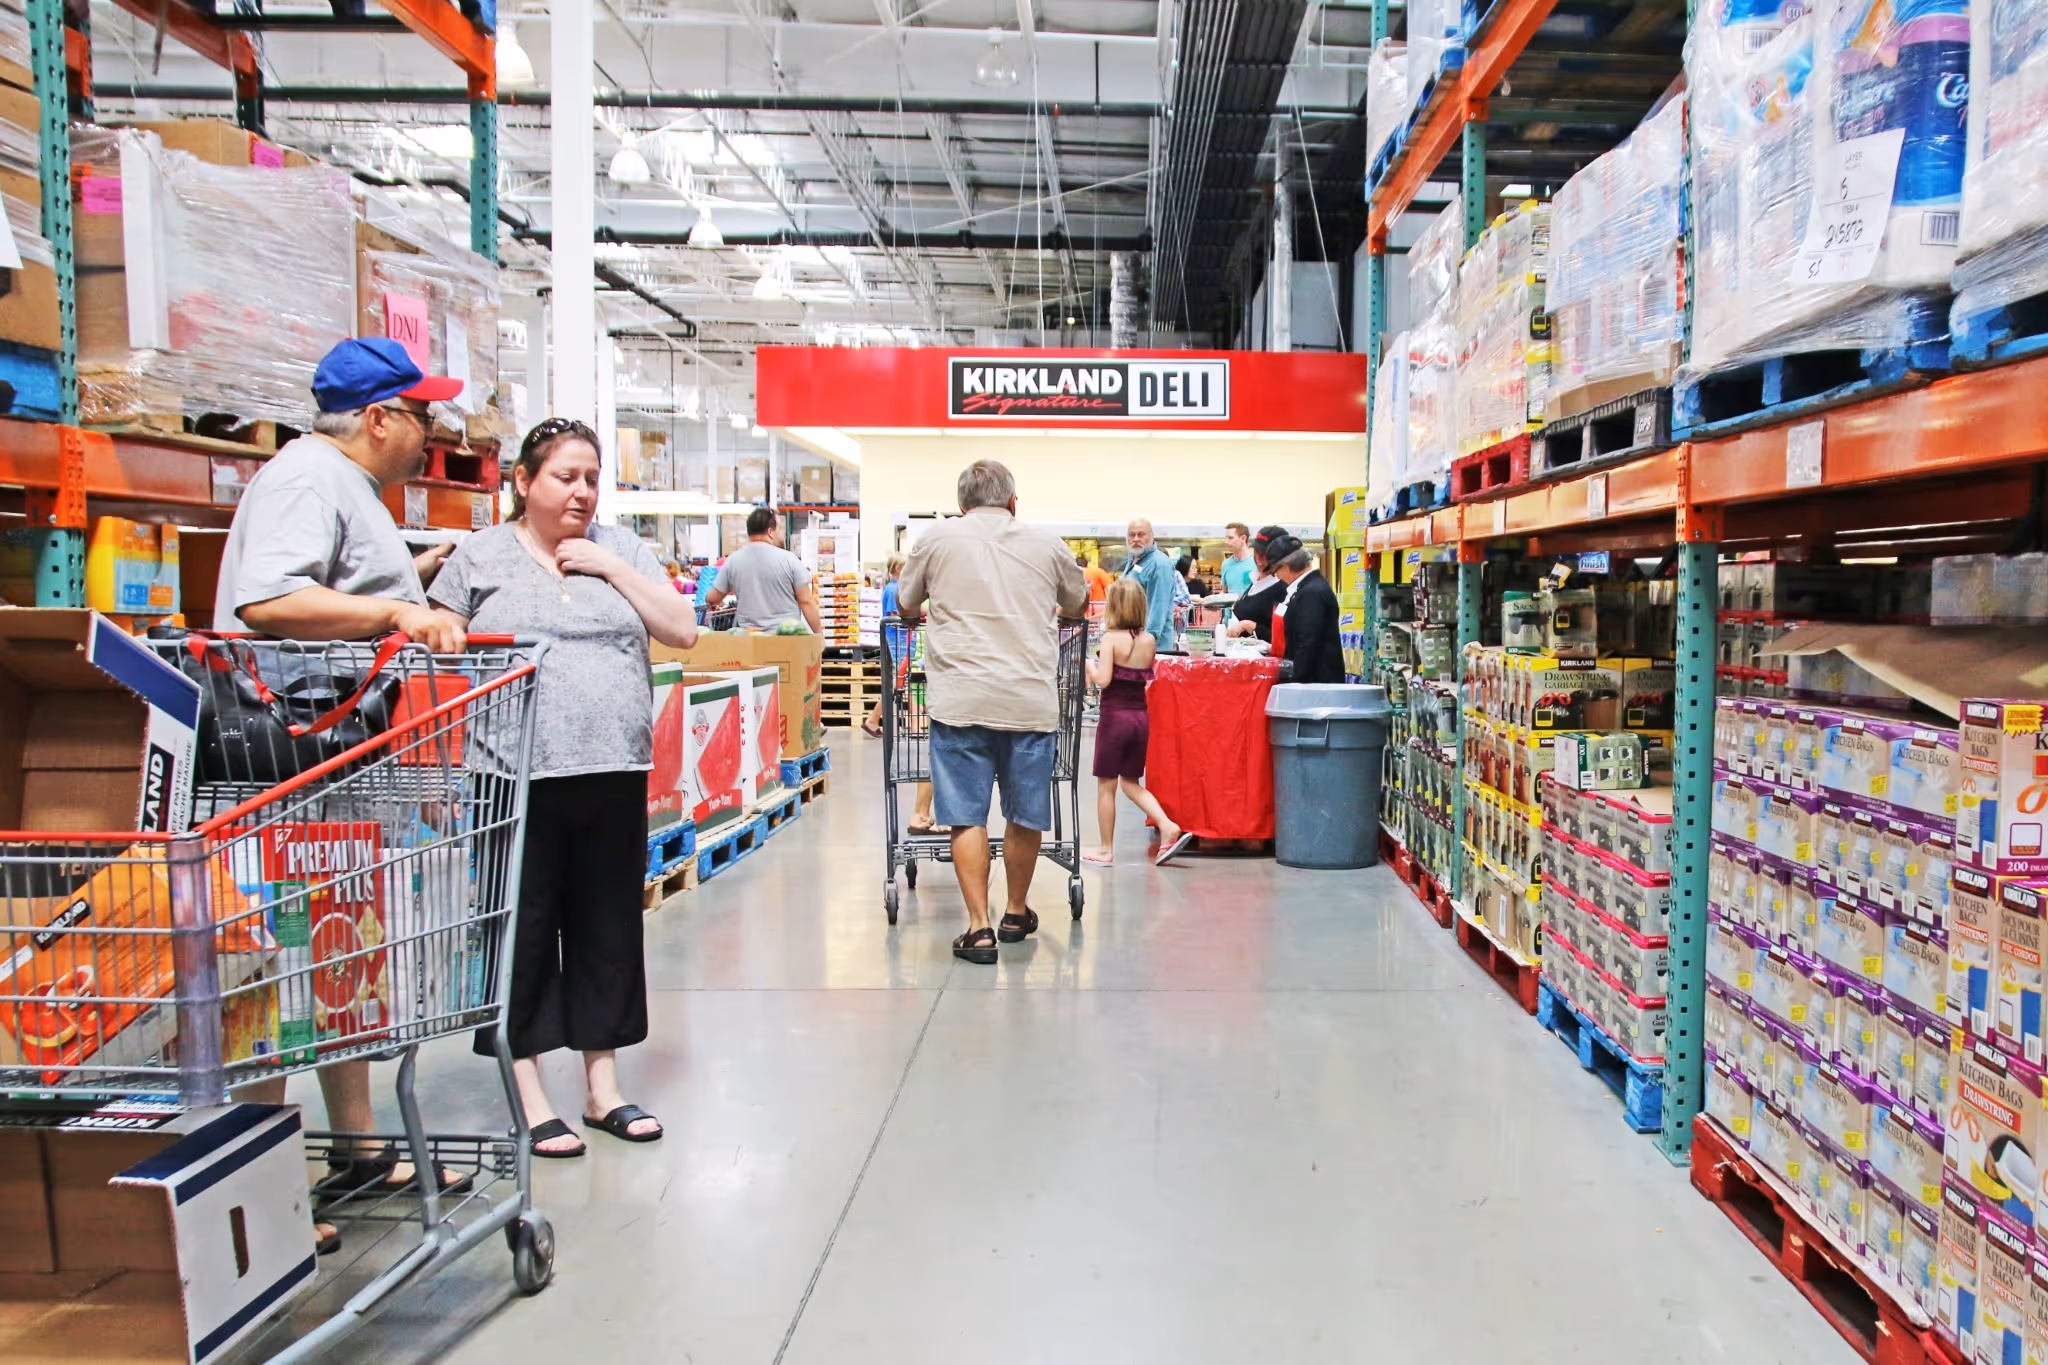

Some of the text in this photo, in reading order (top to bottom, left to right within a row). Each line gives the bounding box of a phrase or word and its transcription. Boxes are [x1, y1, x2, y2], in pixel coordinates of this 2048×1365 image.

[963, 367, 1209, 407] KIRKLAND DELI
[963, 392, 1122, 414] Signature
[1580, 557, 1606, 569] finish
[1544, 672, 1611, 681] DRAWSTRING
[1829, 731, 1874, 752] KITCHEN BAGS
[1964, 727, 1997, 745] KITCHEN
[1897, 744, 1949, 767] KITCHEN BAGS
[1971, 744, 1989, 757] BAGS
[183, 741, 192, 788] MAIGRE
[1963, 757, 1997, 773] DRAWSTRING
[174, 759, 183, 806] PATTIES
[708, 793, 732, 813] Yum-Yum!
[1785, 806, 1799, 821] BAGS
[288, 839, 374, 874] PREMIUM
[2007, 861, 2028, 872] 200
[334, 873, 374, 903] PLUS
[1954, 894, 1988, 914] KITCHEN
[1825, 904, 1866, 932] KITCHEN BAGS
[1959, 909, 1977, 925] BAGS
[2018, 919, 2040, 936] POUR
[1894, 931, 1940, 966] KITCHEN BAGS
[1779, 964, 1794, 983] BAGS
[1958, 1056, 2024, 1108] KITCHEN BAGS
[1964, 1084, 2014, 1126] DRAWSTRING
[1878, 1113, 1925, 1154] KITCHEN BAGS
[1945, 1186, 1975, 1217] KIRKLAND
[1988, 1221, 2025, 1255] KIRKLAND
[1986, 1243, 2024, 1280] KITCHEN
[1993, 1266, 2014, 1289] BAGS
[1984, 1274, 2024, 1311] DRAWSTRING
